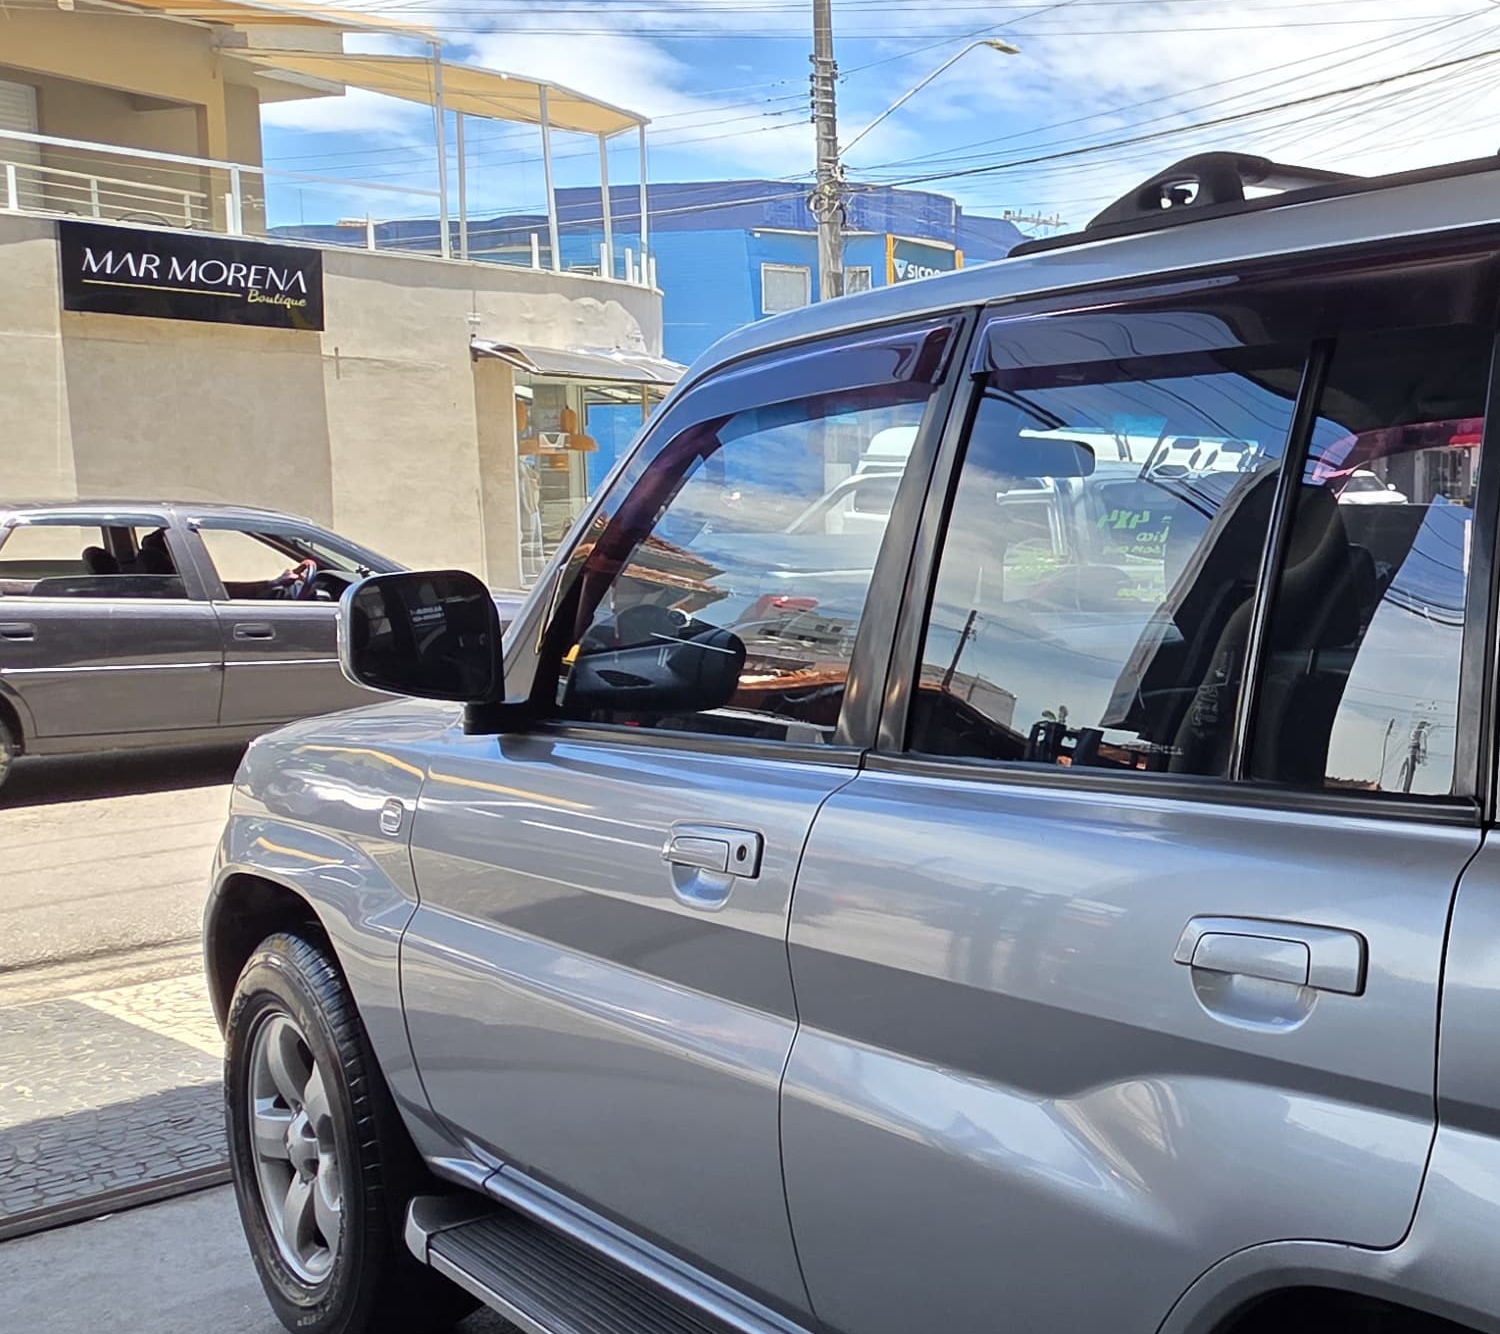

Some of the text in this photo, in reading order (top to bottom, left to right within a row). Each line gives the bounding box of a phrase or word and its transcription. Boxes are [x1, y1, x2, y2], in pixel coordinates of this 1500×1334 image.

[81, 247, 307, 294] MAR MORENA
[907, 264, 943, 280] SICO
[247, 288, 307, 309] Boutique
